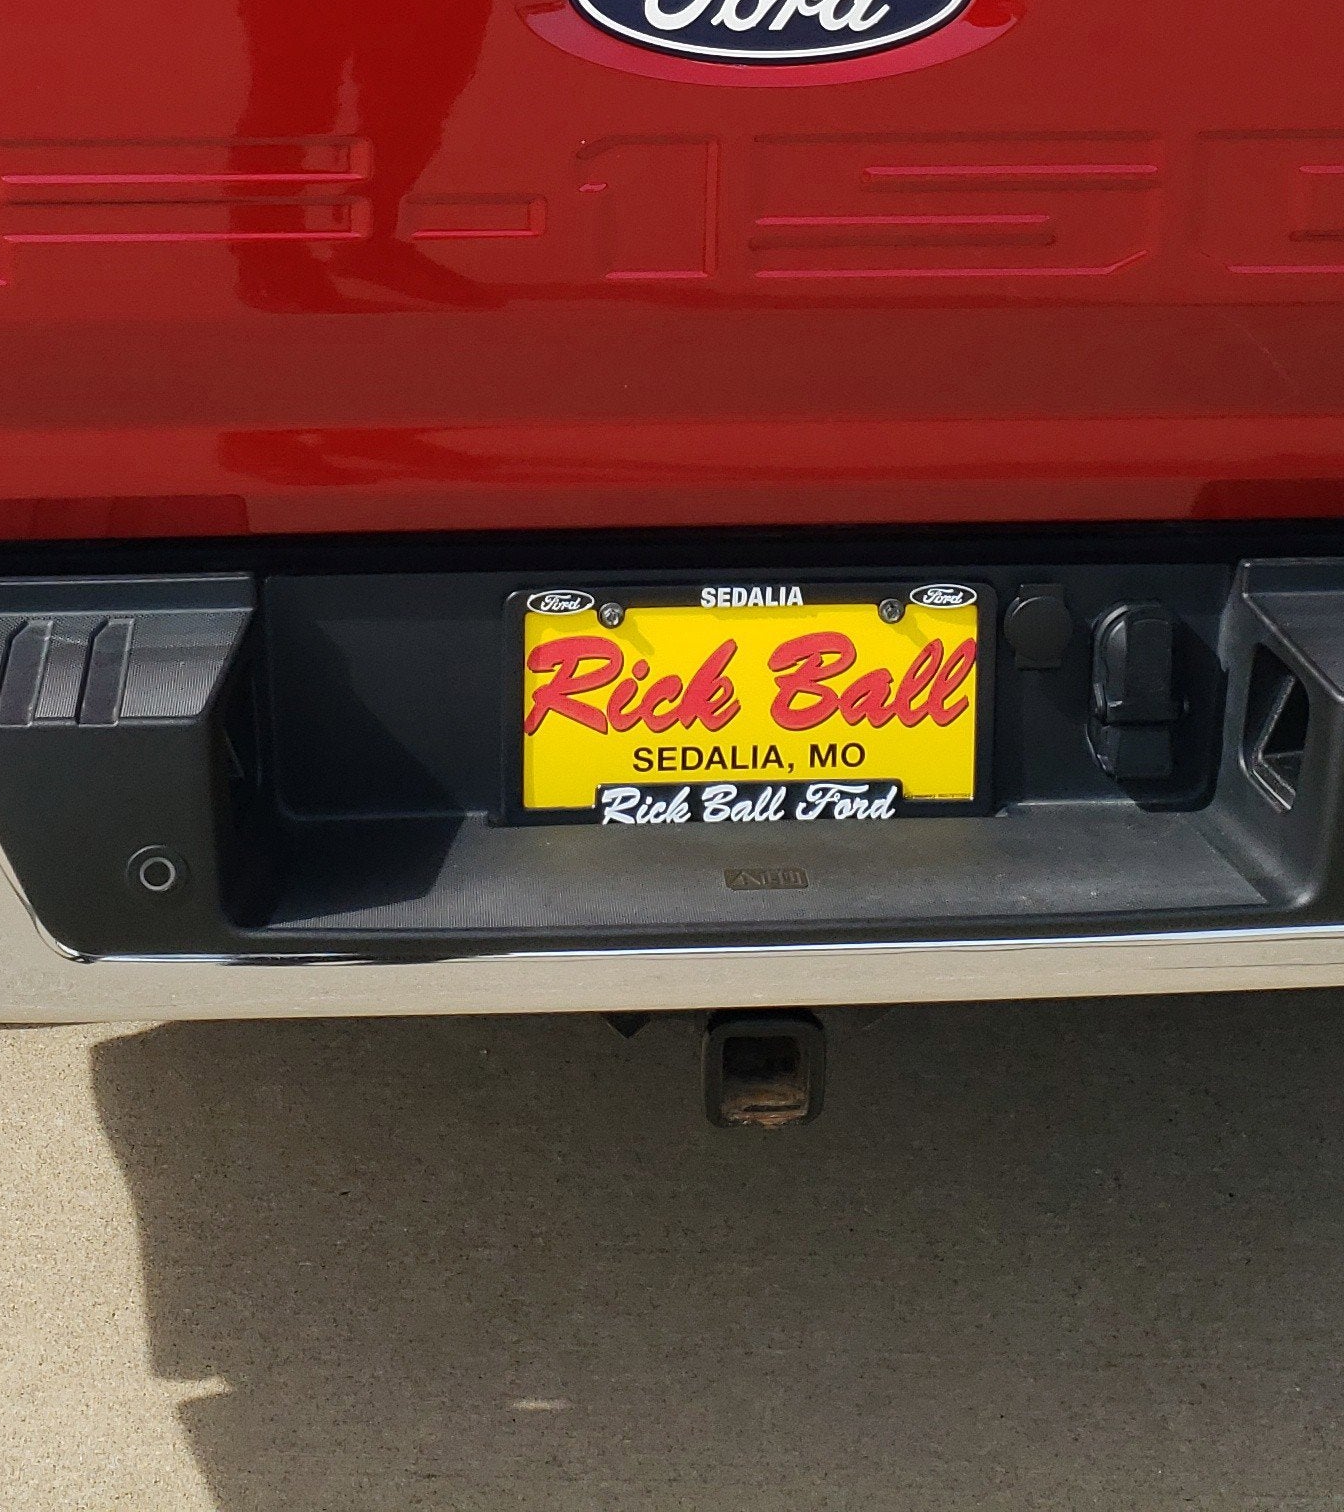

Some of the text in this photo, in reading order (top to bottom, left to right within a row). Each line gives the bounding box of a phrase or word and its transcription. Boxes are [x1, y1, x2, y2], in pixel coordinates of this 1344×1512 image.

[539, 593, 581, 611] Ford
[700, 586, 804, 608] SEDALIA
[921, 587, 964, 607] Ford
[524, 630, 977, 736] Rick Ball
[632, 742, 867, 773] SEDALIA, MO
[601, 782, 897, 826] Rick Ball Ford
